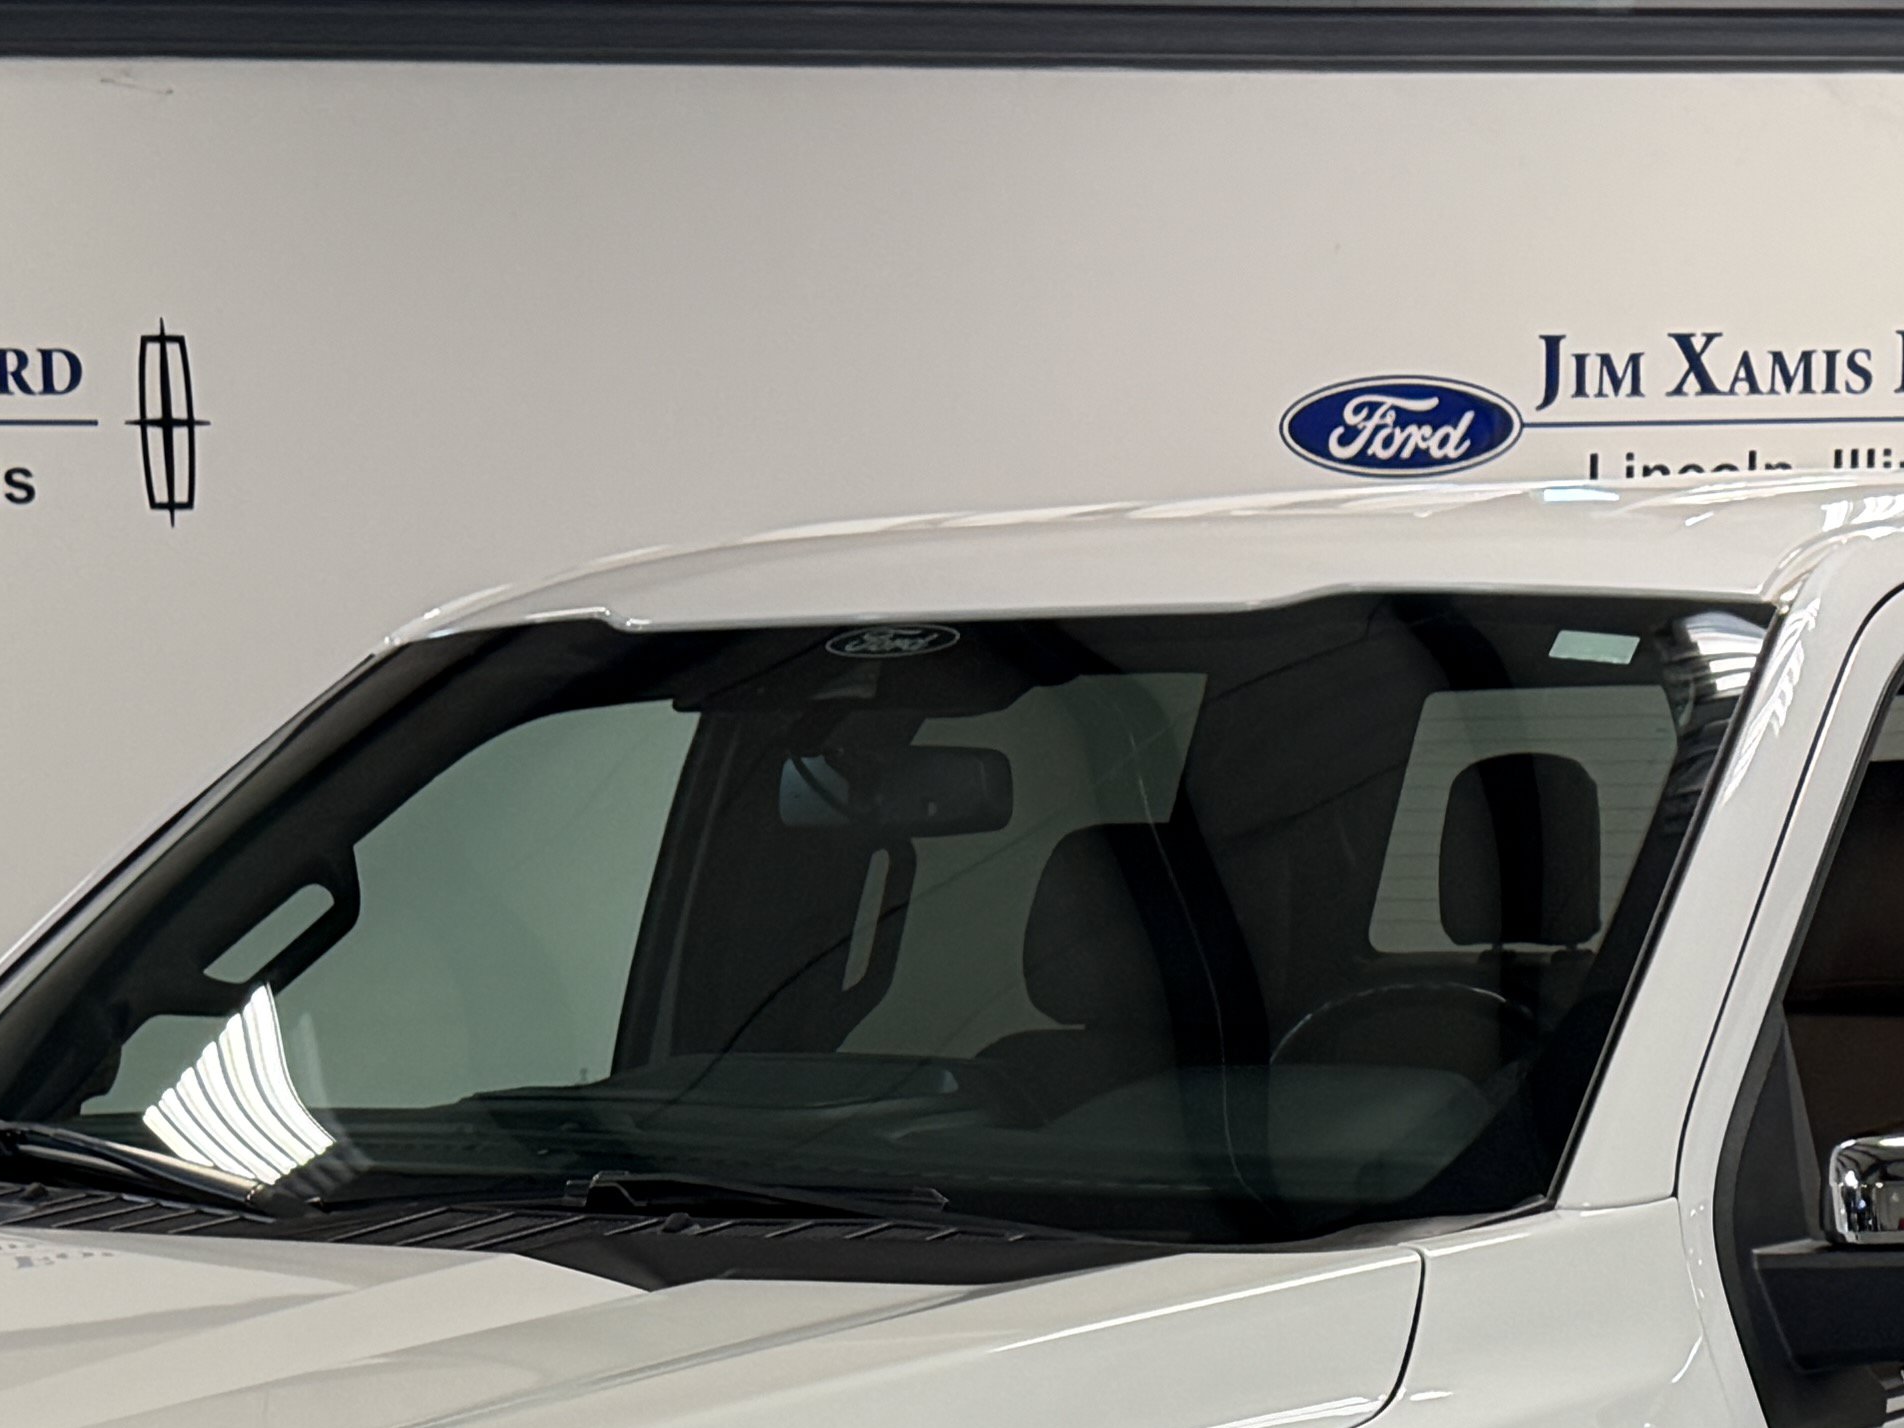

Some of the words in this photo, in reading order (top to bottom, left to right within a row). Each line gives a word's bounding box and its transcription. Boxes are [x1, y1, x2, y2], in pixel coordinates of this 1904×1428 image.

[1536, 333, 1646, 411] JIM
[1665, 331, 1874, 398] XAMIS
[1328, 394, 1472, 462] Ford
